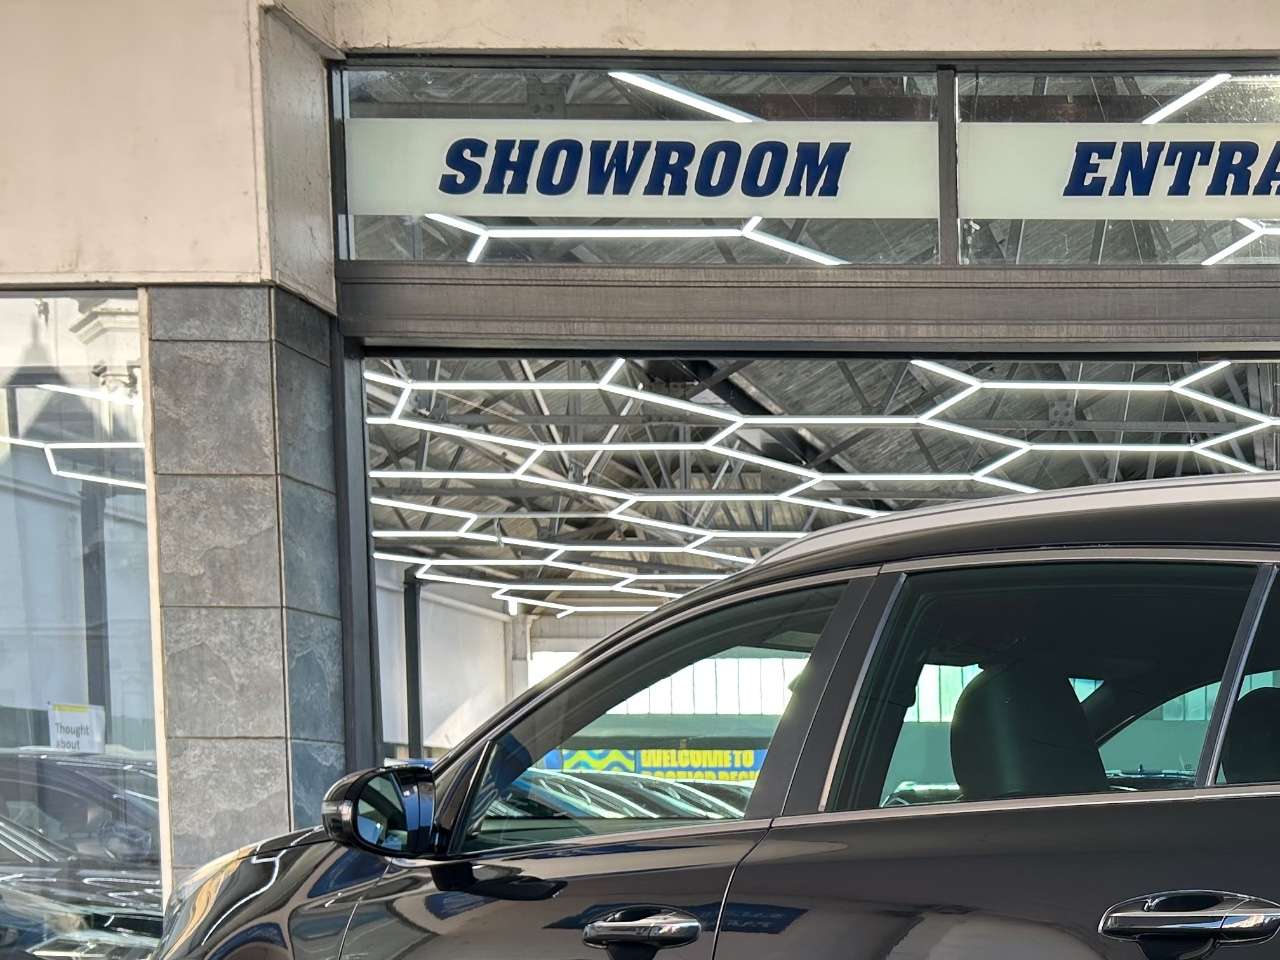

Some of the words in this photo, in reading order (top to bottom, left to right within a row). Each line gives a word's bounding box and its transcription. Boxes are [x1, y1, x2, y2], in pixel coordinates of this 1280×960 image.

[438, 137, 852, 198] SHOWROOM
[55, 722, 90, 738] Thought
[640, 749, 731, 769] WELCOME
[732, 749, 755, 769] TO
